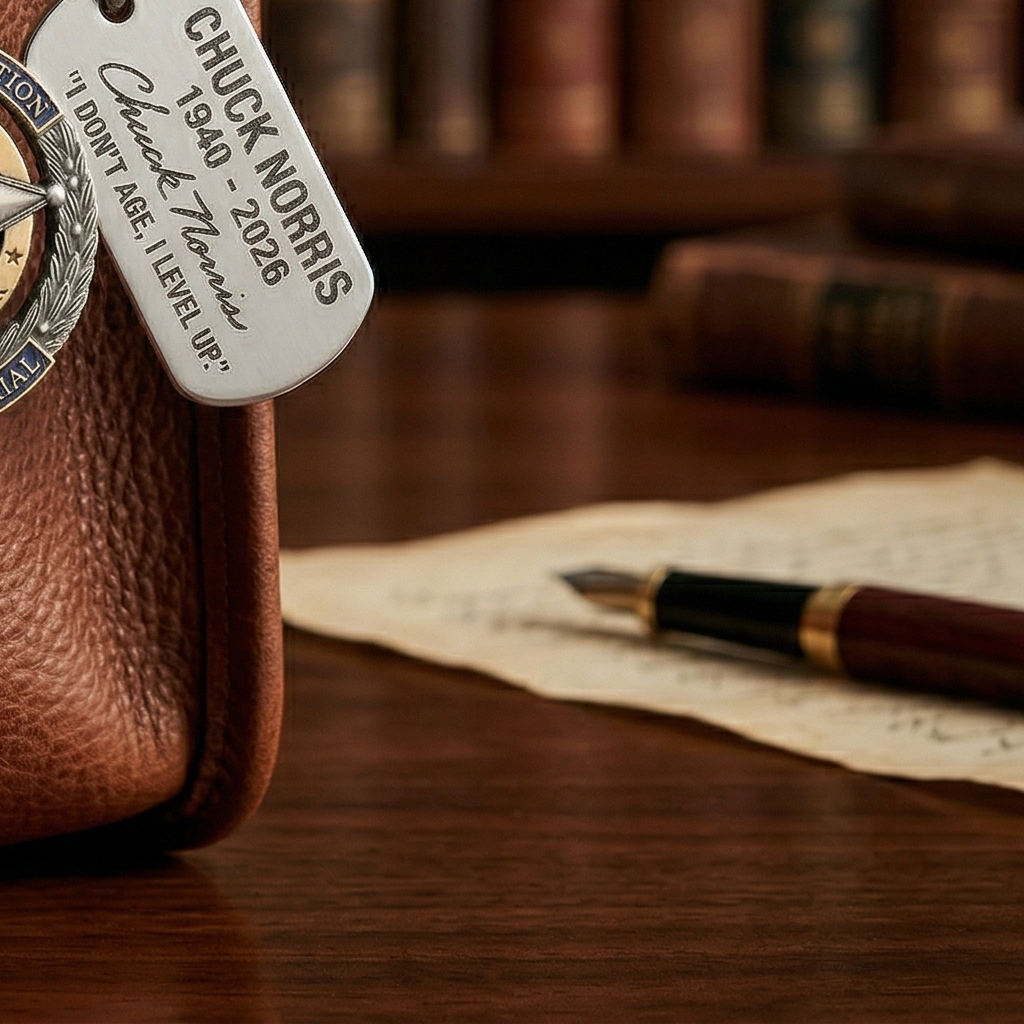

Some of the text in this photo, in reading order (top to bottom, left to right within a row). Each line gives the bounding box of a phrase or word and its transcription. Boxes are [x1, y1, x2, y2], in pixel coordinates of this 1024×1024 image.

[73, 99, 128, 177] DON'T
[183, 6, 353, 305] CHUCK NORRIS
[97, 62, 248, 331] Chuck Norris
[113, 182, 156, 241] AGE,
[176, 84, 232, 169] 1940
[229, 198, 291, 286] 2026
[144, 239, 167, 255] I
[151, 252, 202, 330] LEVEL
